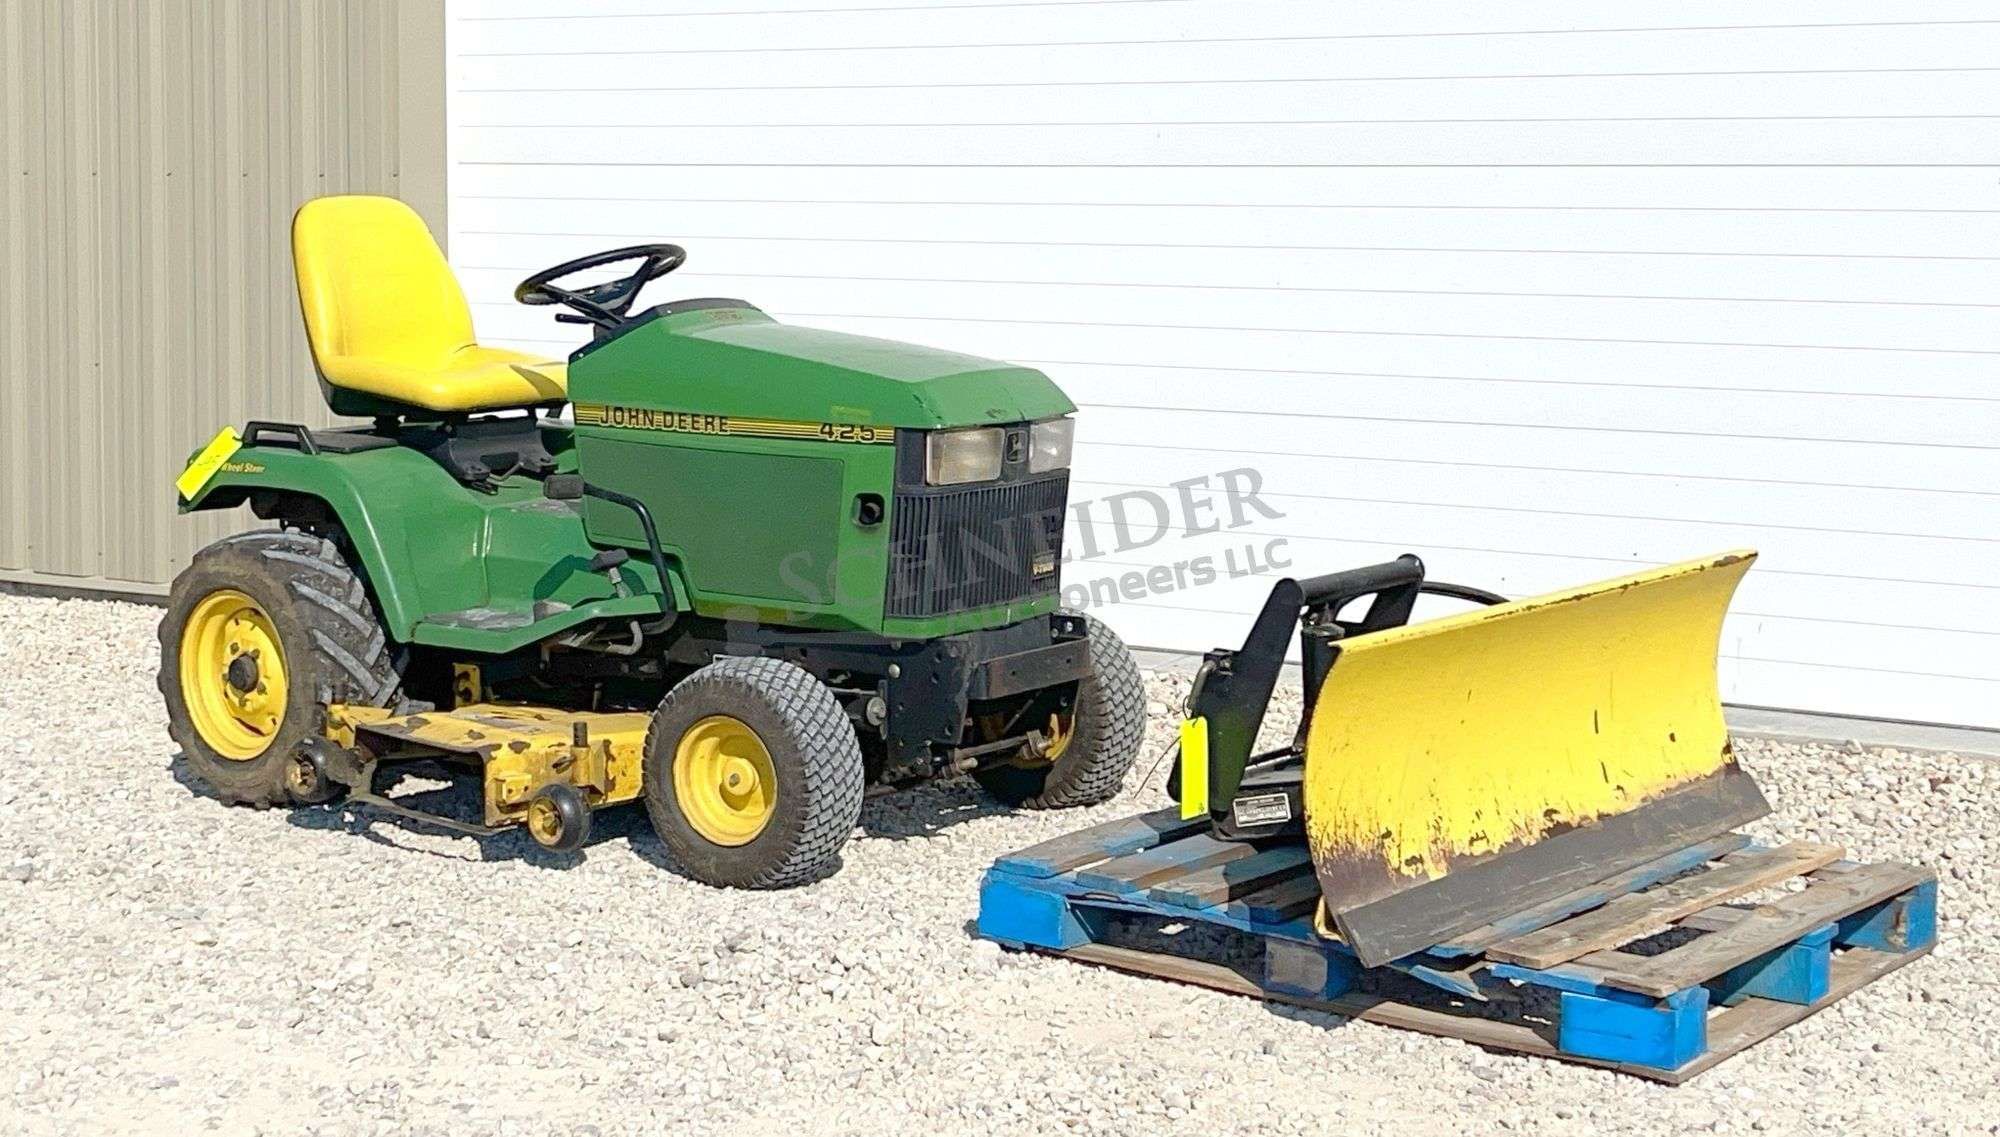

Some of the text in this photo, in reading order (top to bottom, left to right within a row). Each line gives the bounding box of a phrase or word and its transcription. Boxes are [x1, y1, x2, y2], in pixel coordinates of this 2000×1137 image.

[600, 405, 729, 433] JOHN DEERE
[819, 422, 875, 441] 425
